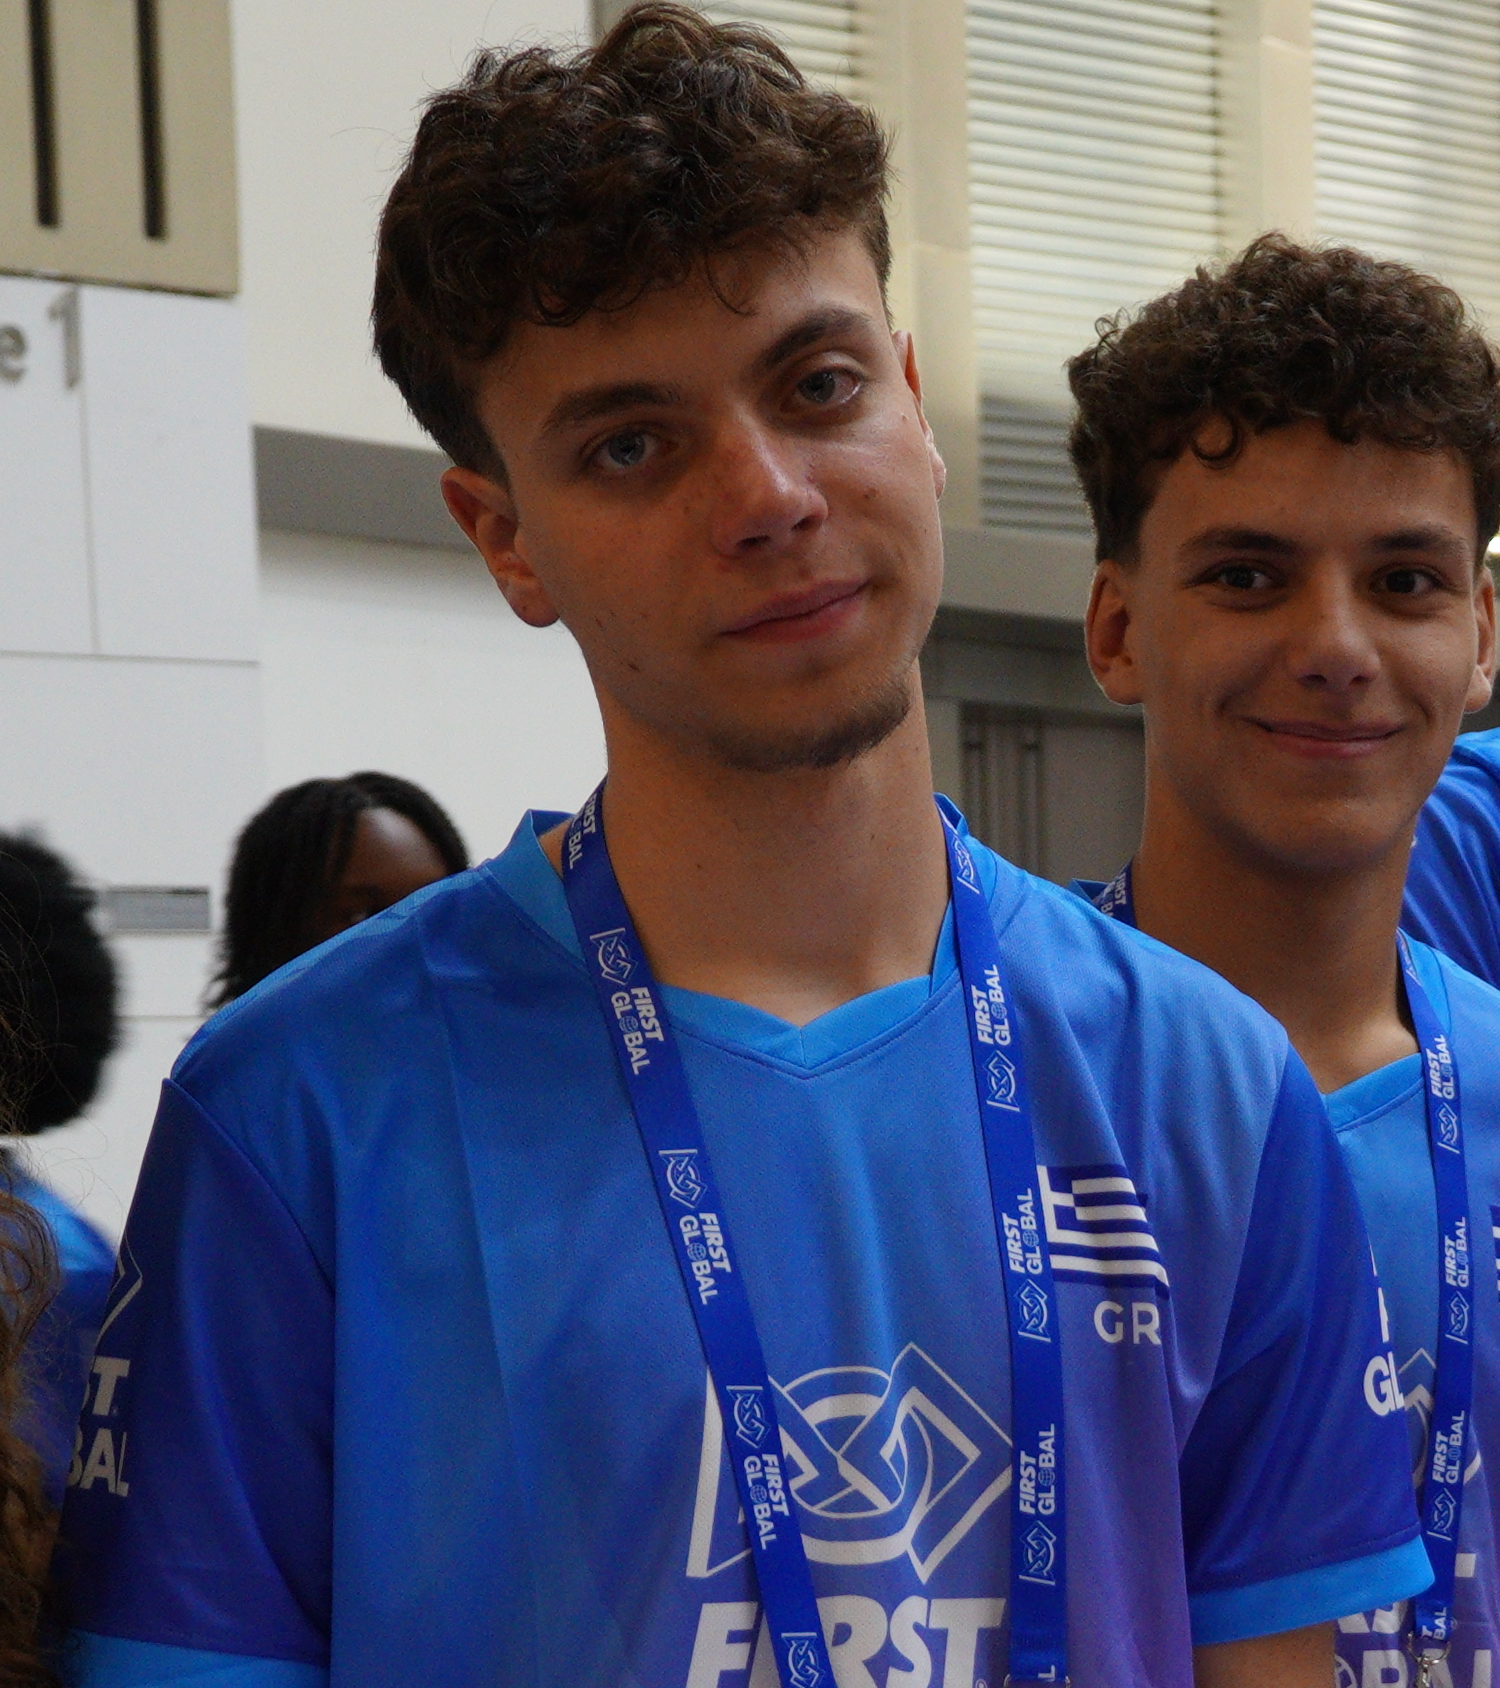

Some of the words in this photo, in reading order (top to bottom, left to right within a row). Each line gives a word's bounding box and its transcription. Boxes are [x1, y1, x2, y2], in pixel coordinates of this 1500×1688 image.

[47, 283, 81, 390] 1
[611, 991, 650, 1076] GLOBAL
[631, 986, 665, 1042] FIRST
[971, 984, 991, 1045] FIRST
[987, 964, 1012, 1047] GLOBAL
[1426, 1048, 1443, 1098] FIRST
[1435, 1033, 1454, 1100] GLOBAL
[680, 1214, 718, 1305] GLOBAL
[699, 1212, 731, 1273] FIRST
[1009, 1212, 1024, 1273] FIRST
[1025, 1188, 1043, 1275] GLOBAL
[1445, 1235, 1458, 1287] FIRST
[1457, 1216, 1470, 1288] GLOBAL
[1093, 1301, 1162, 1345] GR
[1037, 1423, 1056, 1515] GLOBAL
[1432, 1431, 1449, 1484] FIRST
[1445, 1409, 1465, 1484] GLOBAL
[744, 1455, 776, 1550] GLOBAL
[762, 1453, 789, 1517] FIRST
[1019, 1450, 1037, 1514] FIRST
